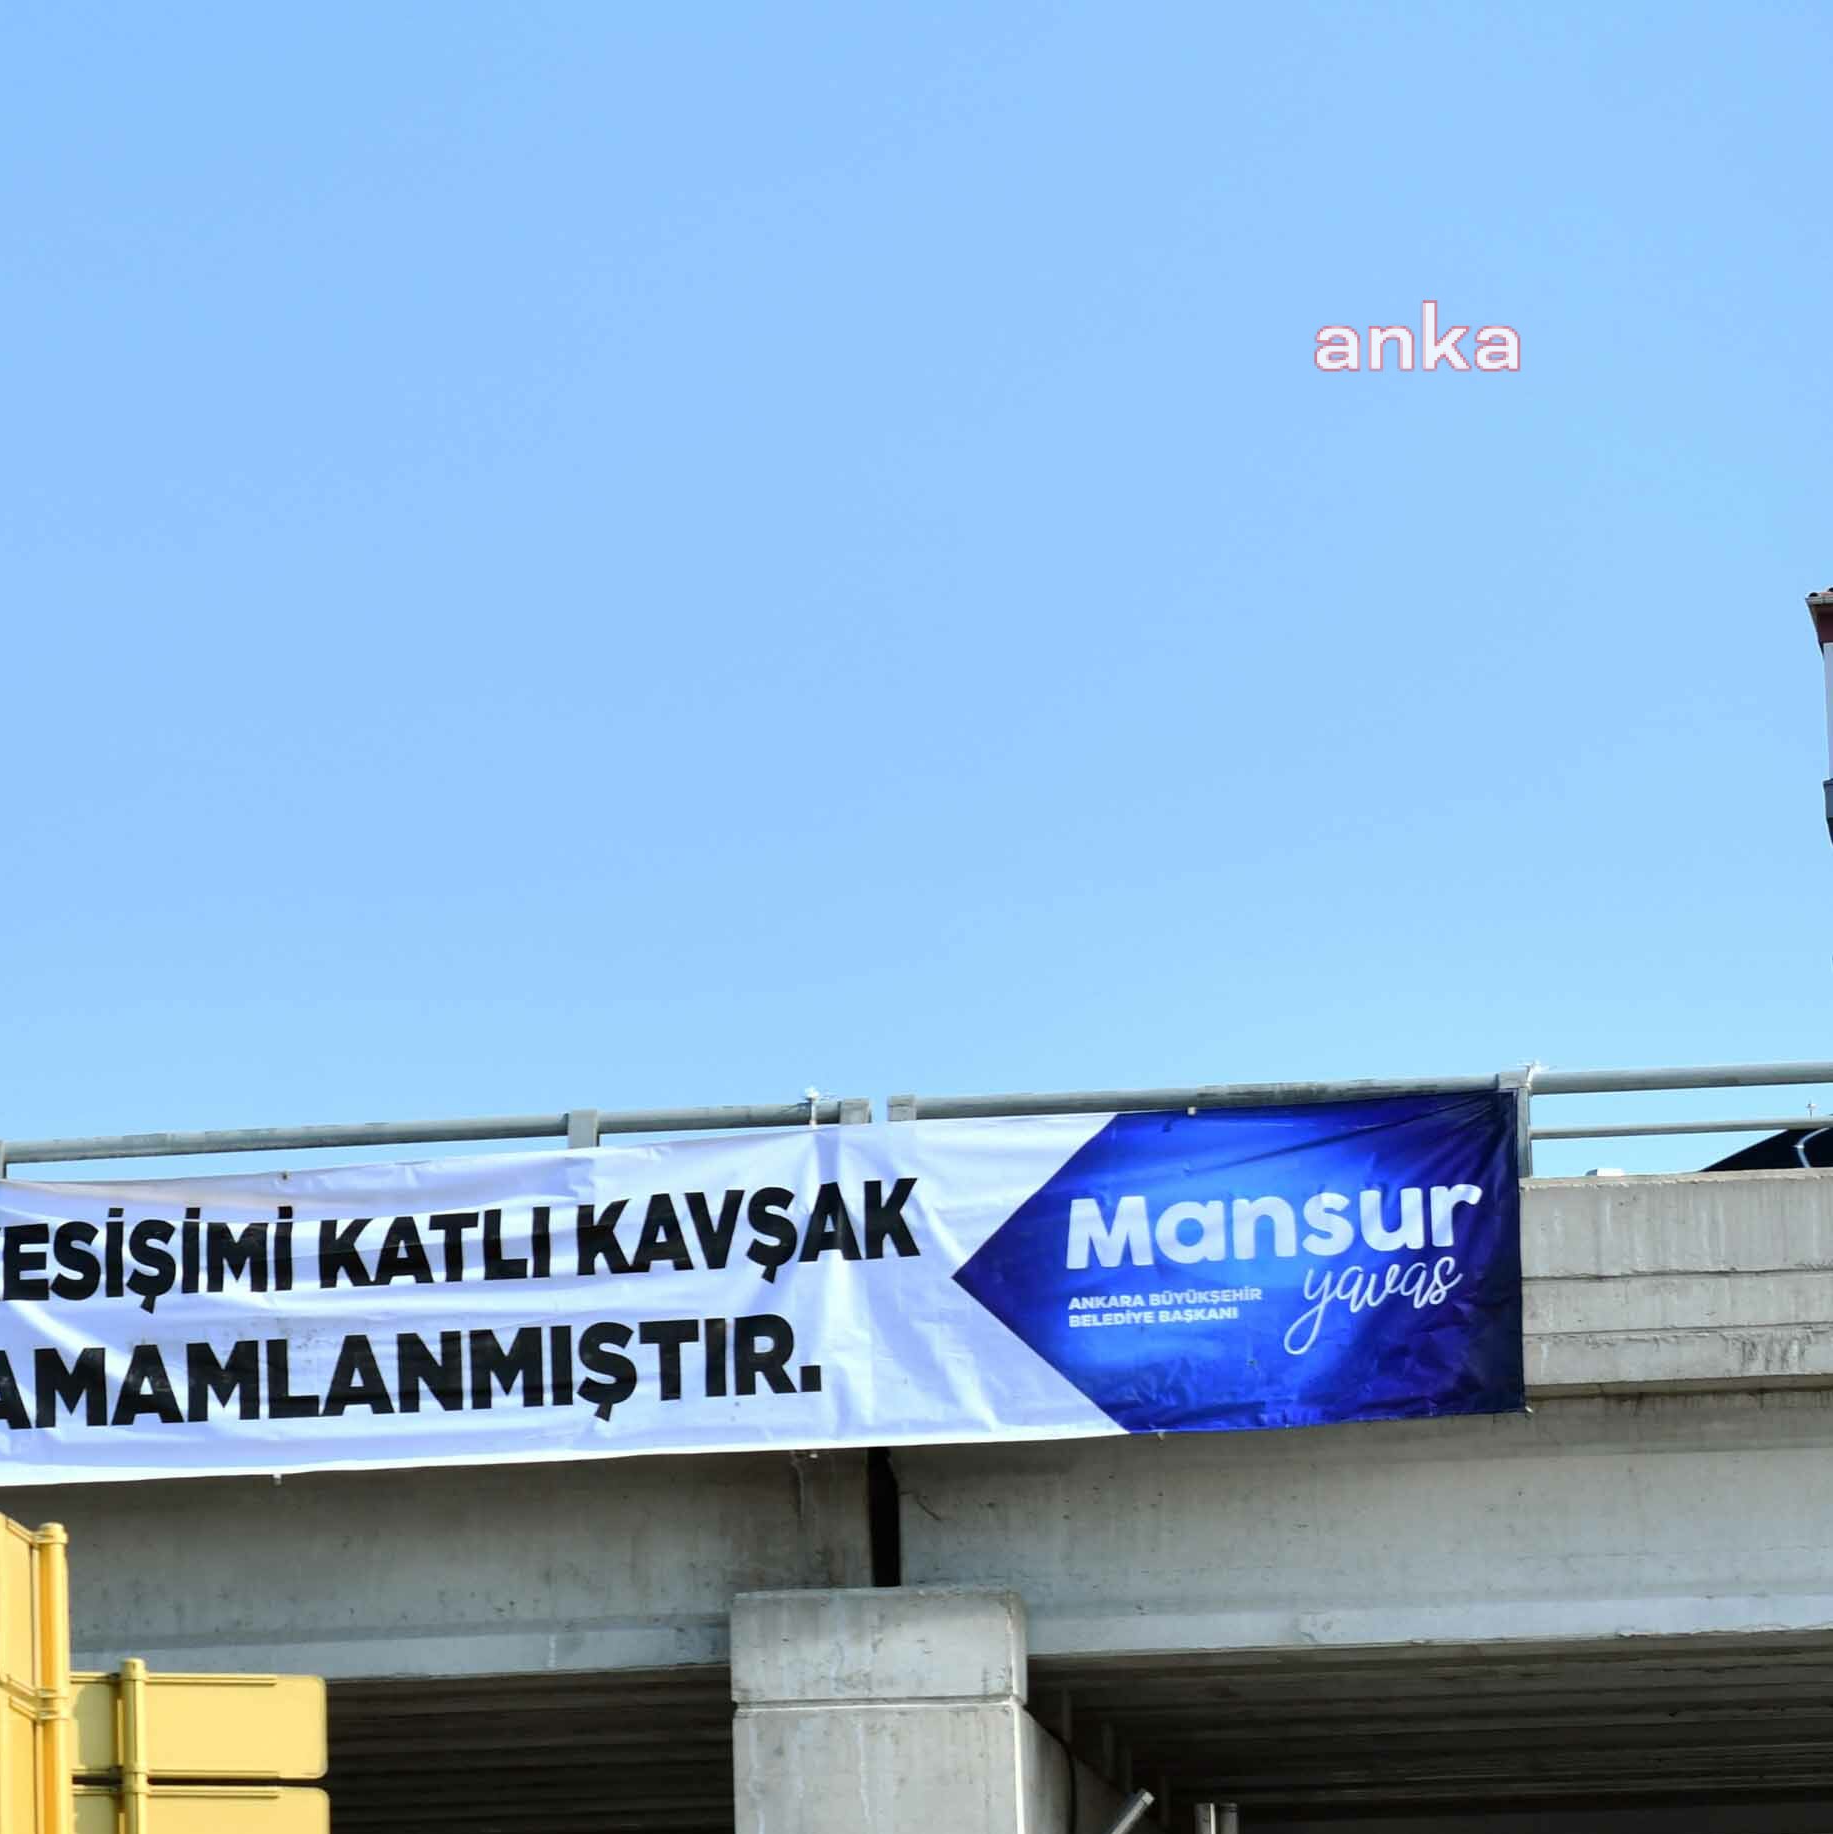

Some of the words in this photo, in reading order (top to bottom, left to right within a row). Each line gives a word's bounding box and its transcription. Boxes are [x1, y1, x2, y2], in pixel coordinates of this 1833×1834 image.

[318, 1206, 551, 1289] KATLI
[576, 1177, 921, 1284] KAVŞAK
[1065, 1183, 1483, 1270] Mansur
[1068, 1294, 1144, 1311] ANKARA
[1148, 1287, 1262, 1310] BÜYÜKŞEHİR
[1068, 1308, 1155, 1328] BELEDİYE
[1158, 1305, 1239, 1326] BAŞKANI
